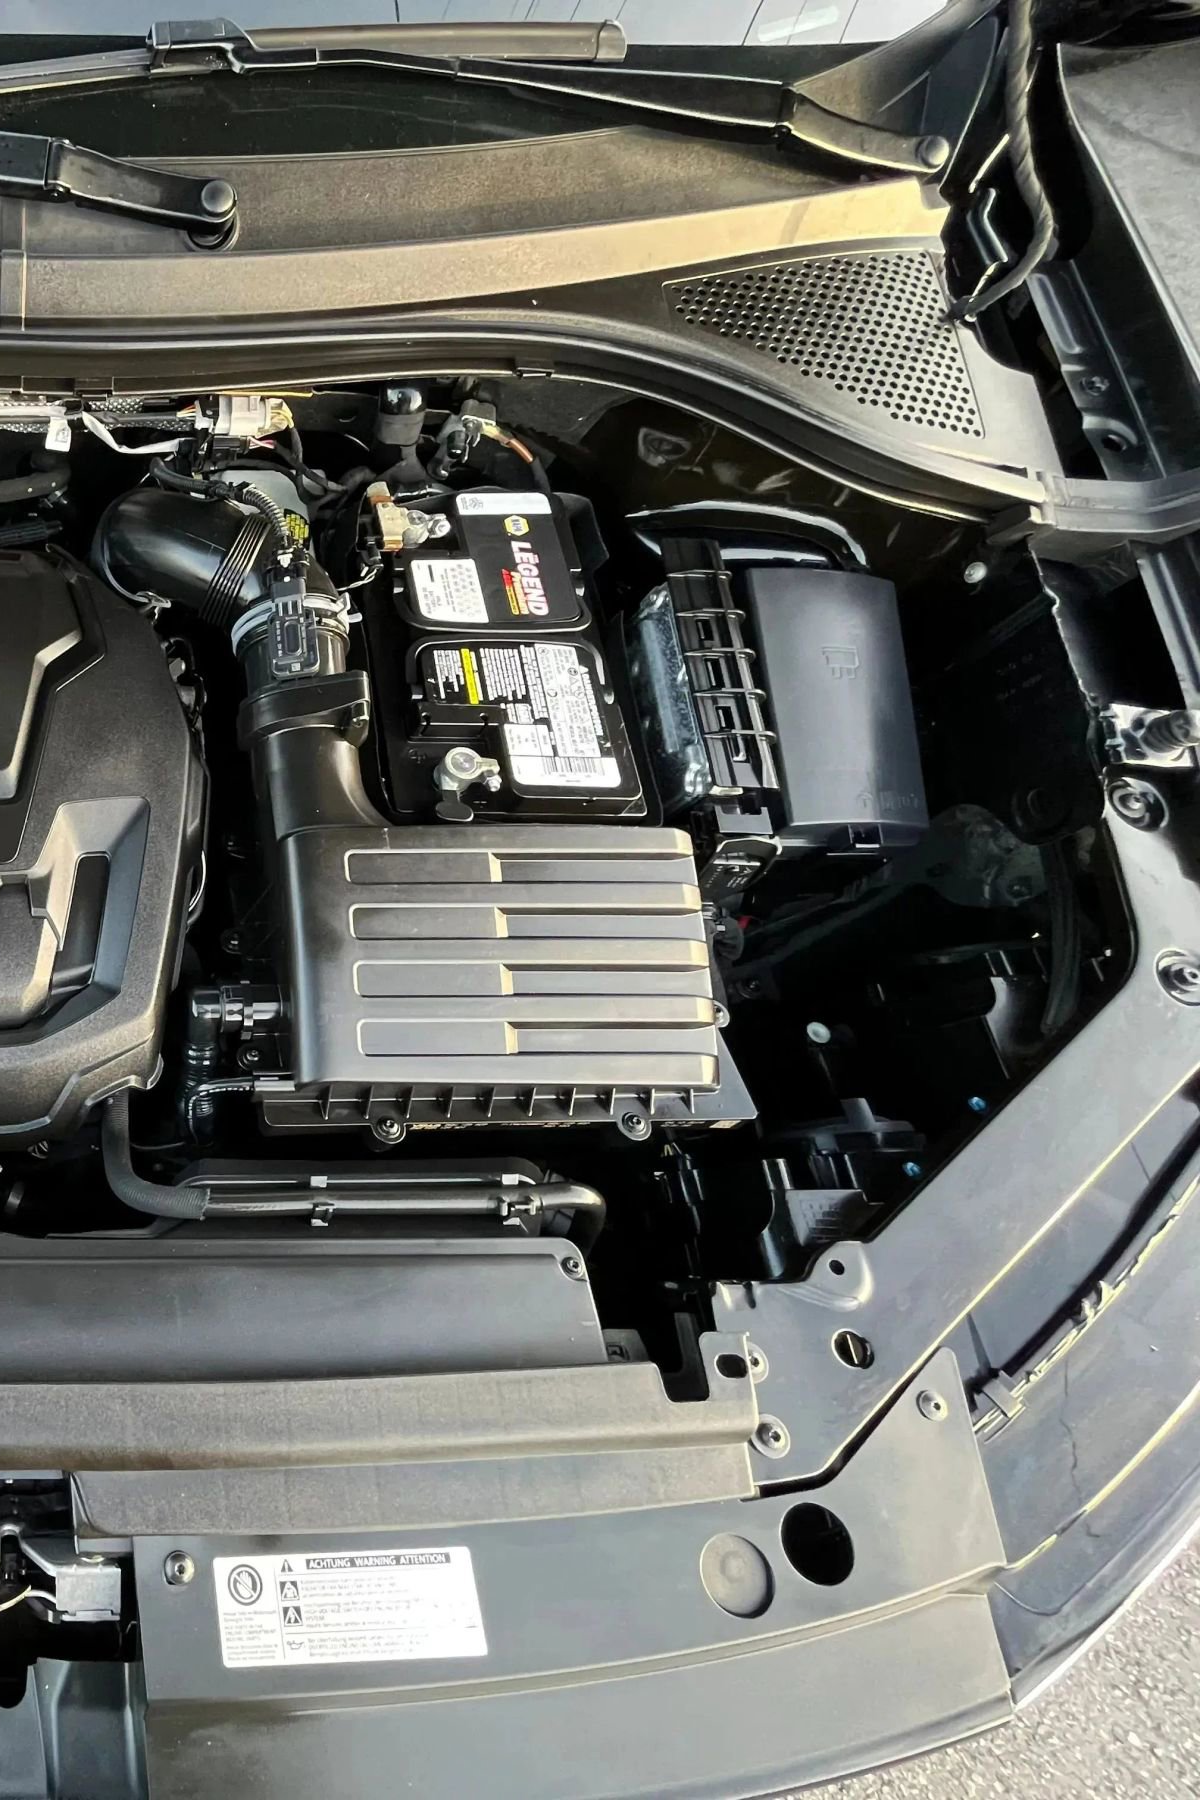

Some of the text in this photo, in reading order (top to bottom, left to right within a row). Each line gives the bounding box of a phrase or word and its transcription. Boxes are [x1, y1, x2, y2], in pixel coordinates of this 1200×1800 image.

[511, 541, 549, 616] LEGEND
[308, 1553, 446, 1569] ACHTUNG WARNING ATTENTION
